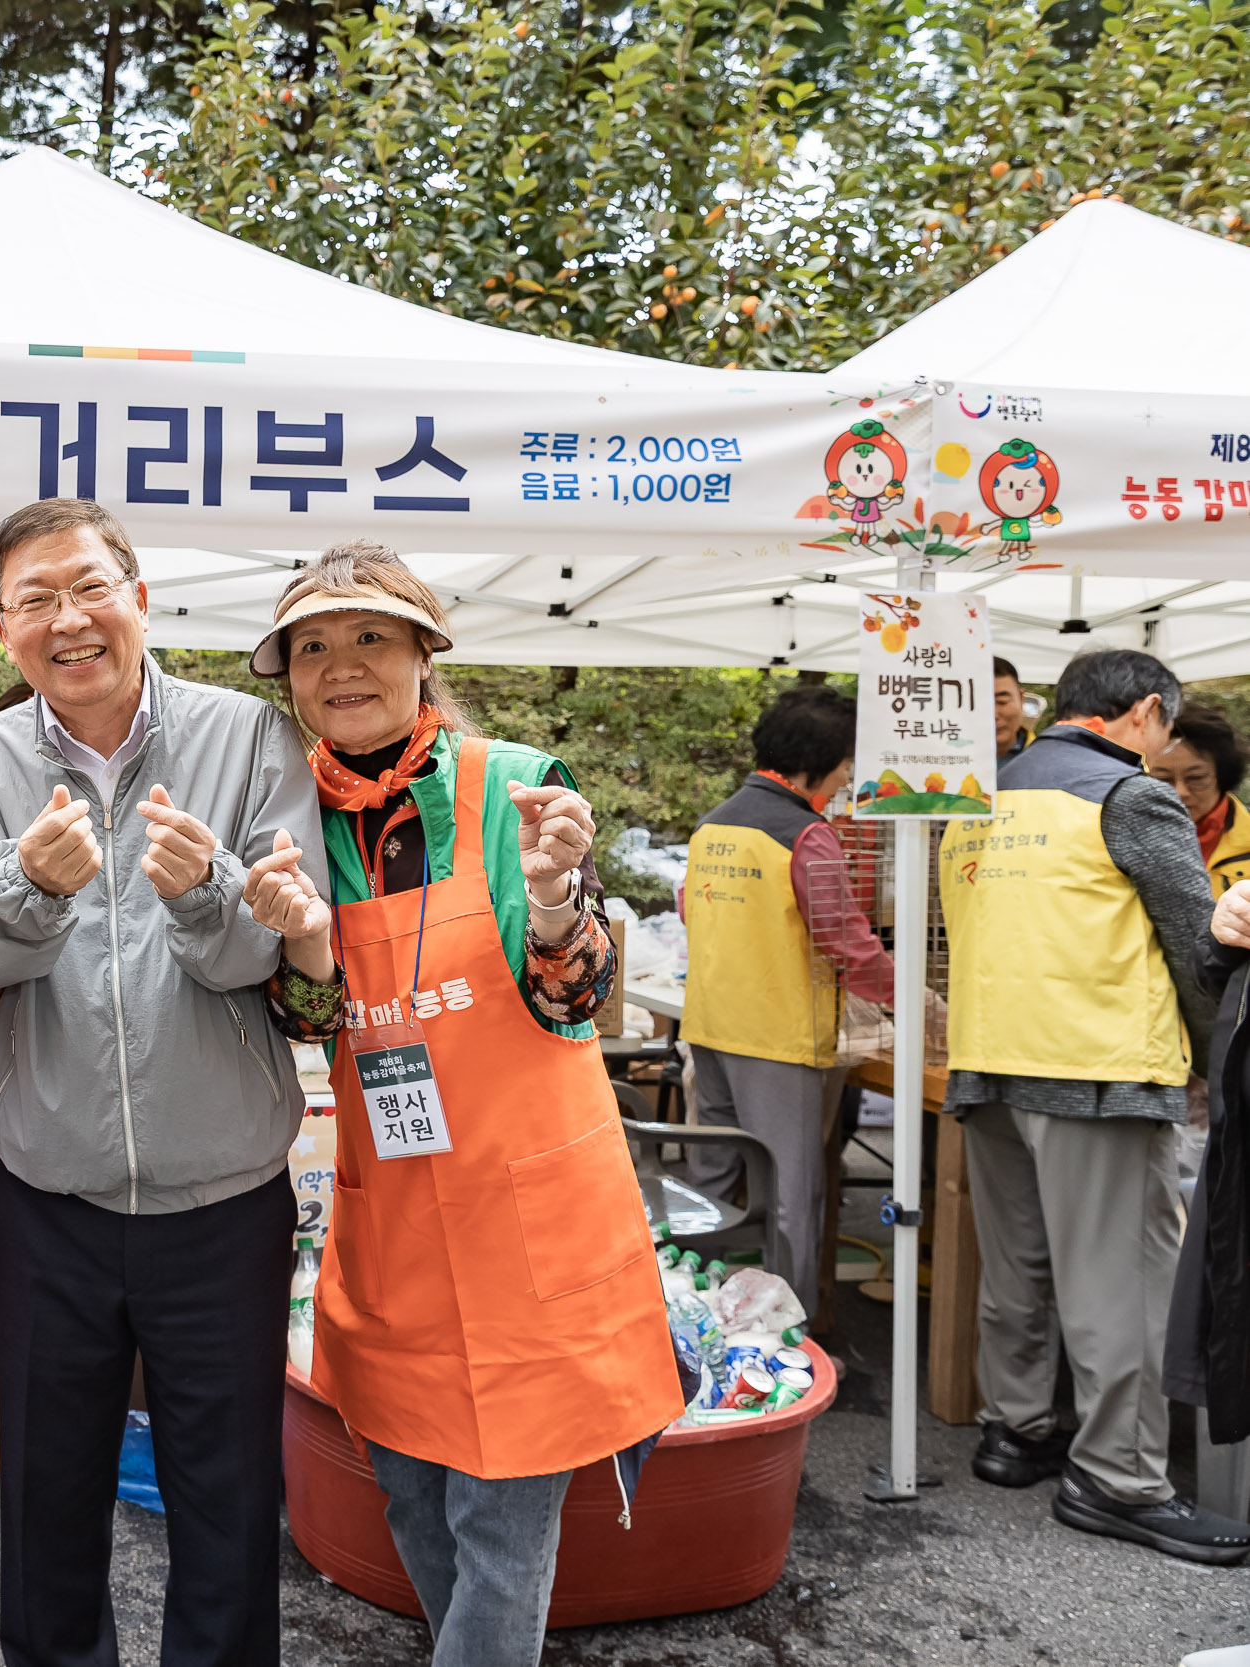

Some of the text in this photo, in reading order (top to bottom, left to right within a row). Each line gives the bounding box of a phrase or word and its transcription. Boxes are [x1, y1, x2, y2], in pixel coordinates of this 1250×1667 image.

[520, 432, 579, 462] 주류
[607, 434, 742, 466] 2,000원
[521, 472, 580, 500] 음료
[608, 473, 732, 506] 1,000원
[1121, 476, 1183, 521] 능동
[902, 646, 952, 668] 사랑의
[893, 719, 962, 741] 무료 나눔
[410, 977, 474, 1020] 능동
[362, 1061, 427, 1081] 능동감마을축제
[378, 1055, 404, 1067] 제8회
[376, 1089, 427, 1119] 행사
[384, 1116, 435, 1144] 지원
